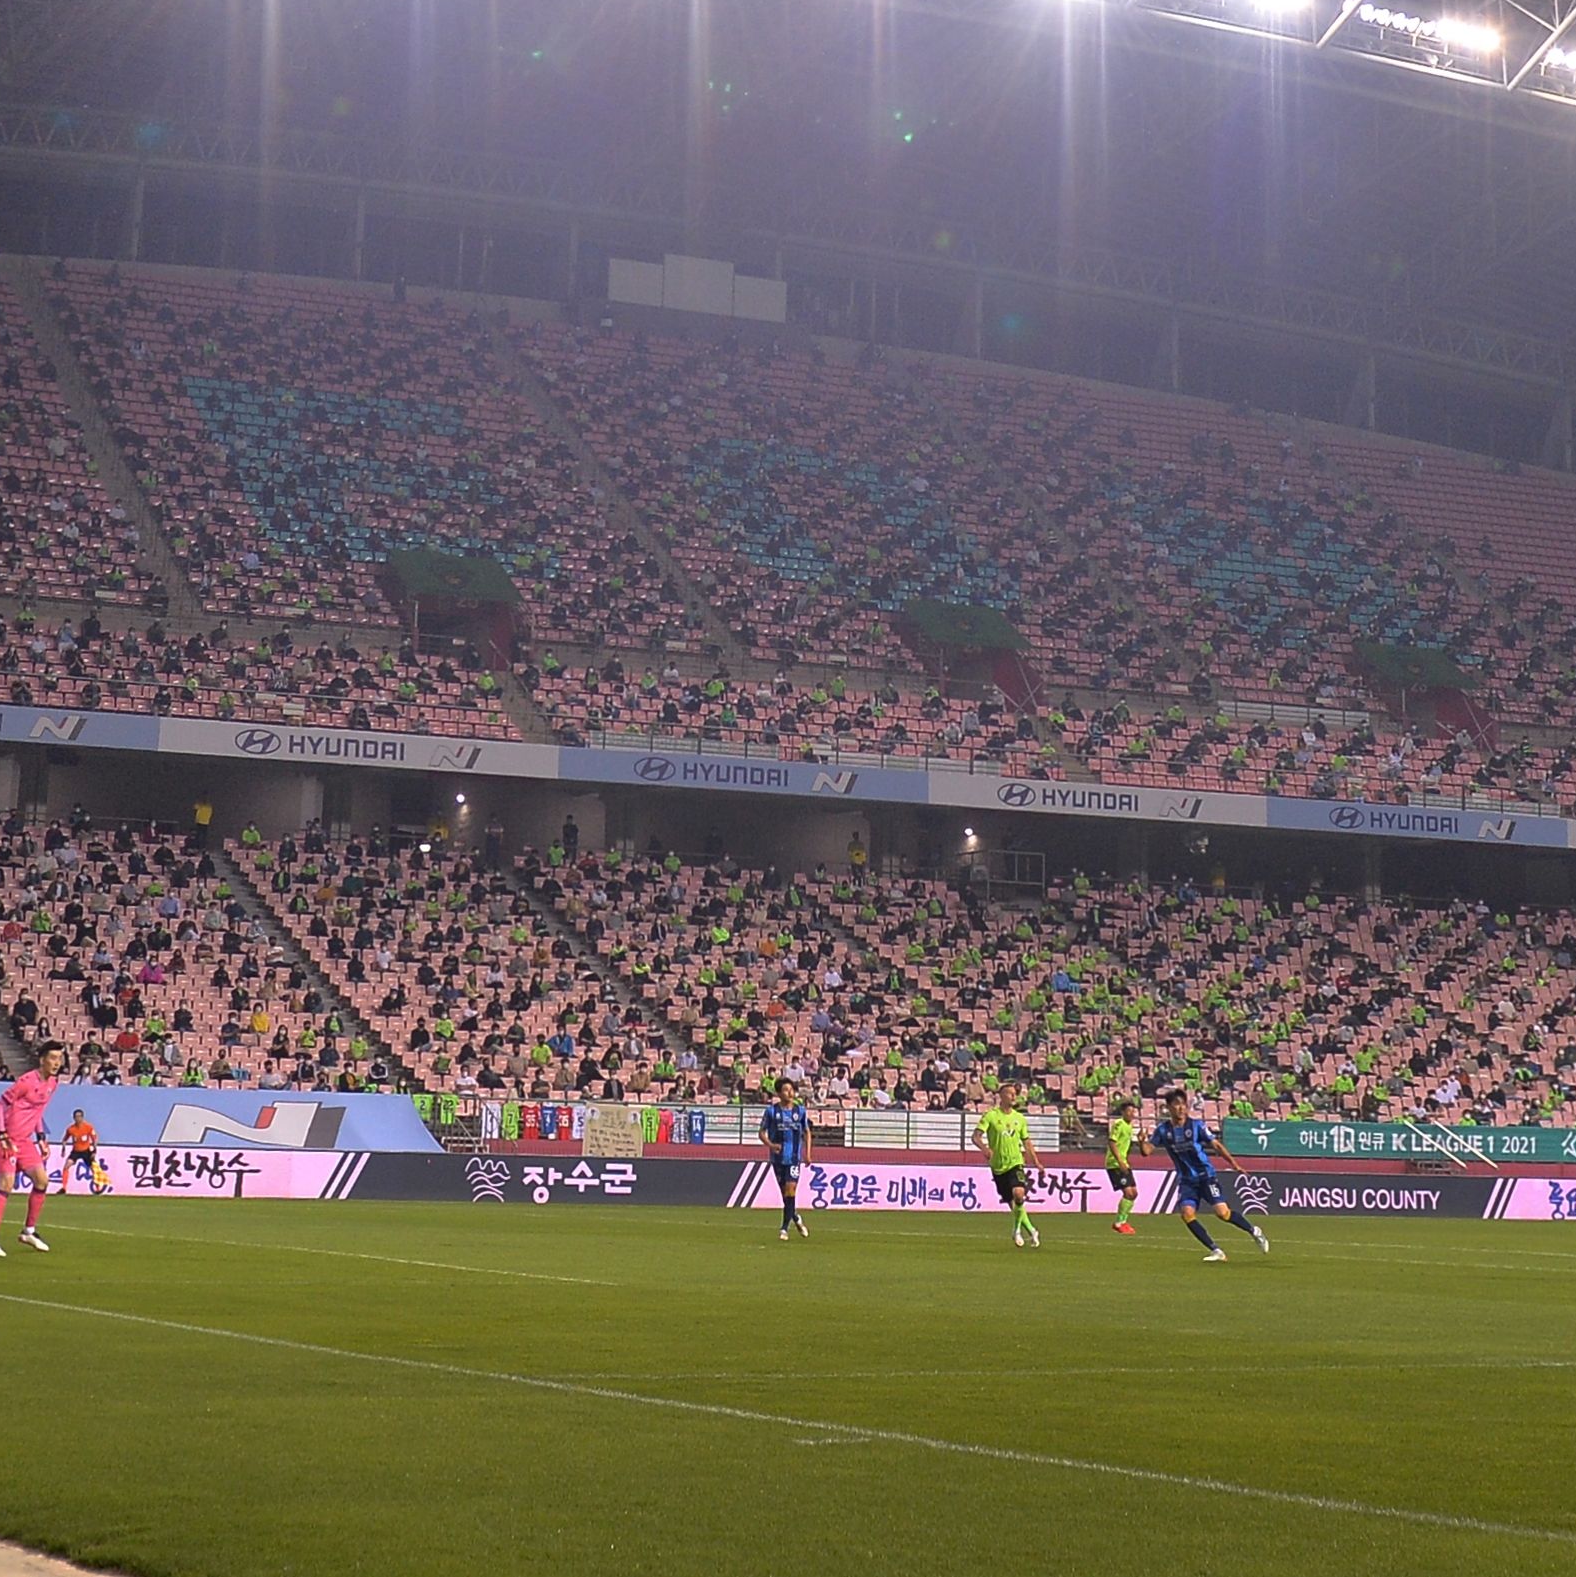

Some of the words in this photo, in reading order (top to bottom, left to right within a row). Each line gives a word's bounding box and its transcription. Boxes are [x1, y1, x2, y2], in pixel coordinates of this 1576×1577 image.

[288, 734, 405, 762] HYUNDAI
[683, 762, 789, 787] HYUNDAI
[1041, 787, 1139, 812] HYUNDAI
[1370, 811, 1459, 834] HYUNDAI
[1391, 1132, 1408, 1152] K
[1411, 1132, 1484, 1154] LEAGUE
[1487, 1134, 1495, 1154] 1
[1502, 1134, 1537, 1154] 2021
[522, 1160, 638, 1205] 장수군
[887, 1176, 945, 1207] 미래의
[1279, 1186, 1357, 1210] JANGSU
[1361, 1188, 1441, 1211] COUNTY
